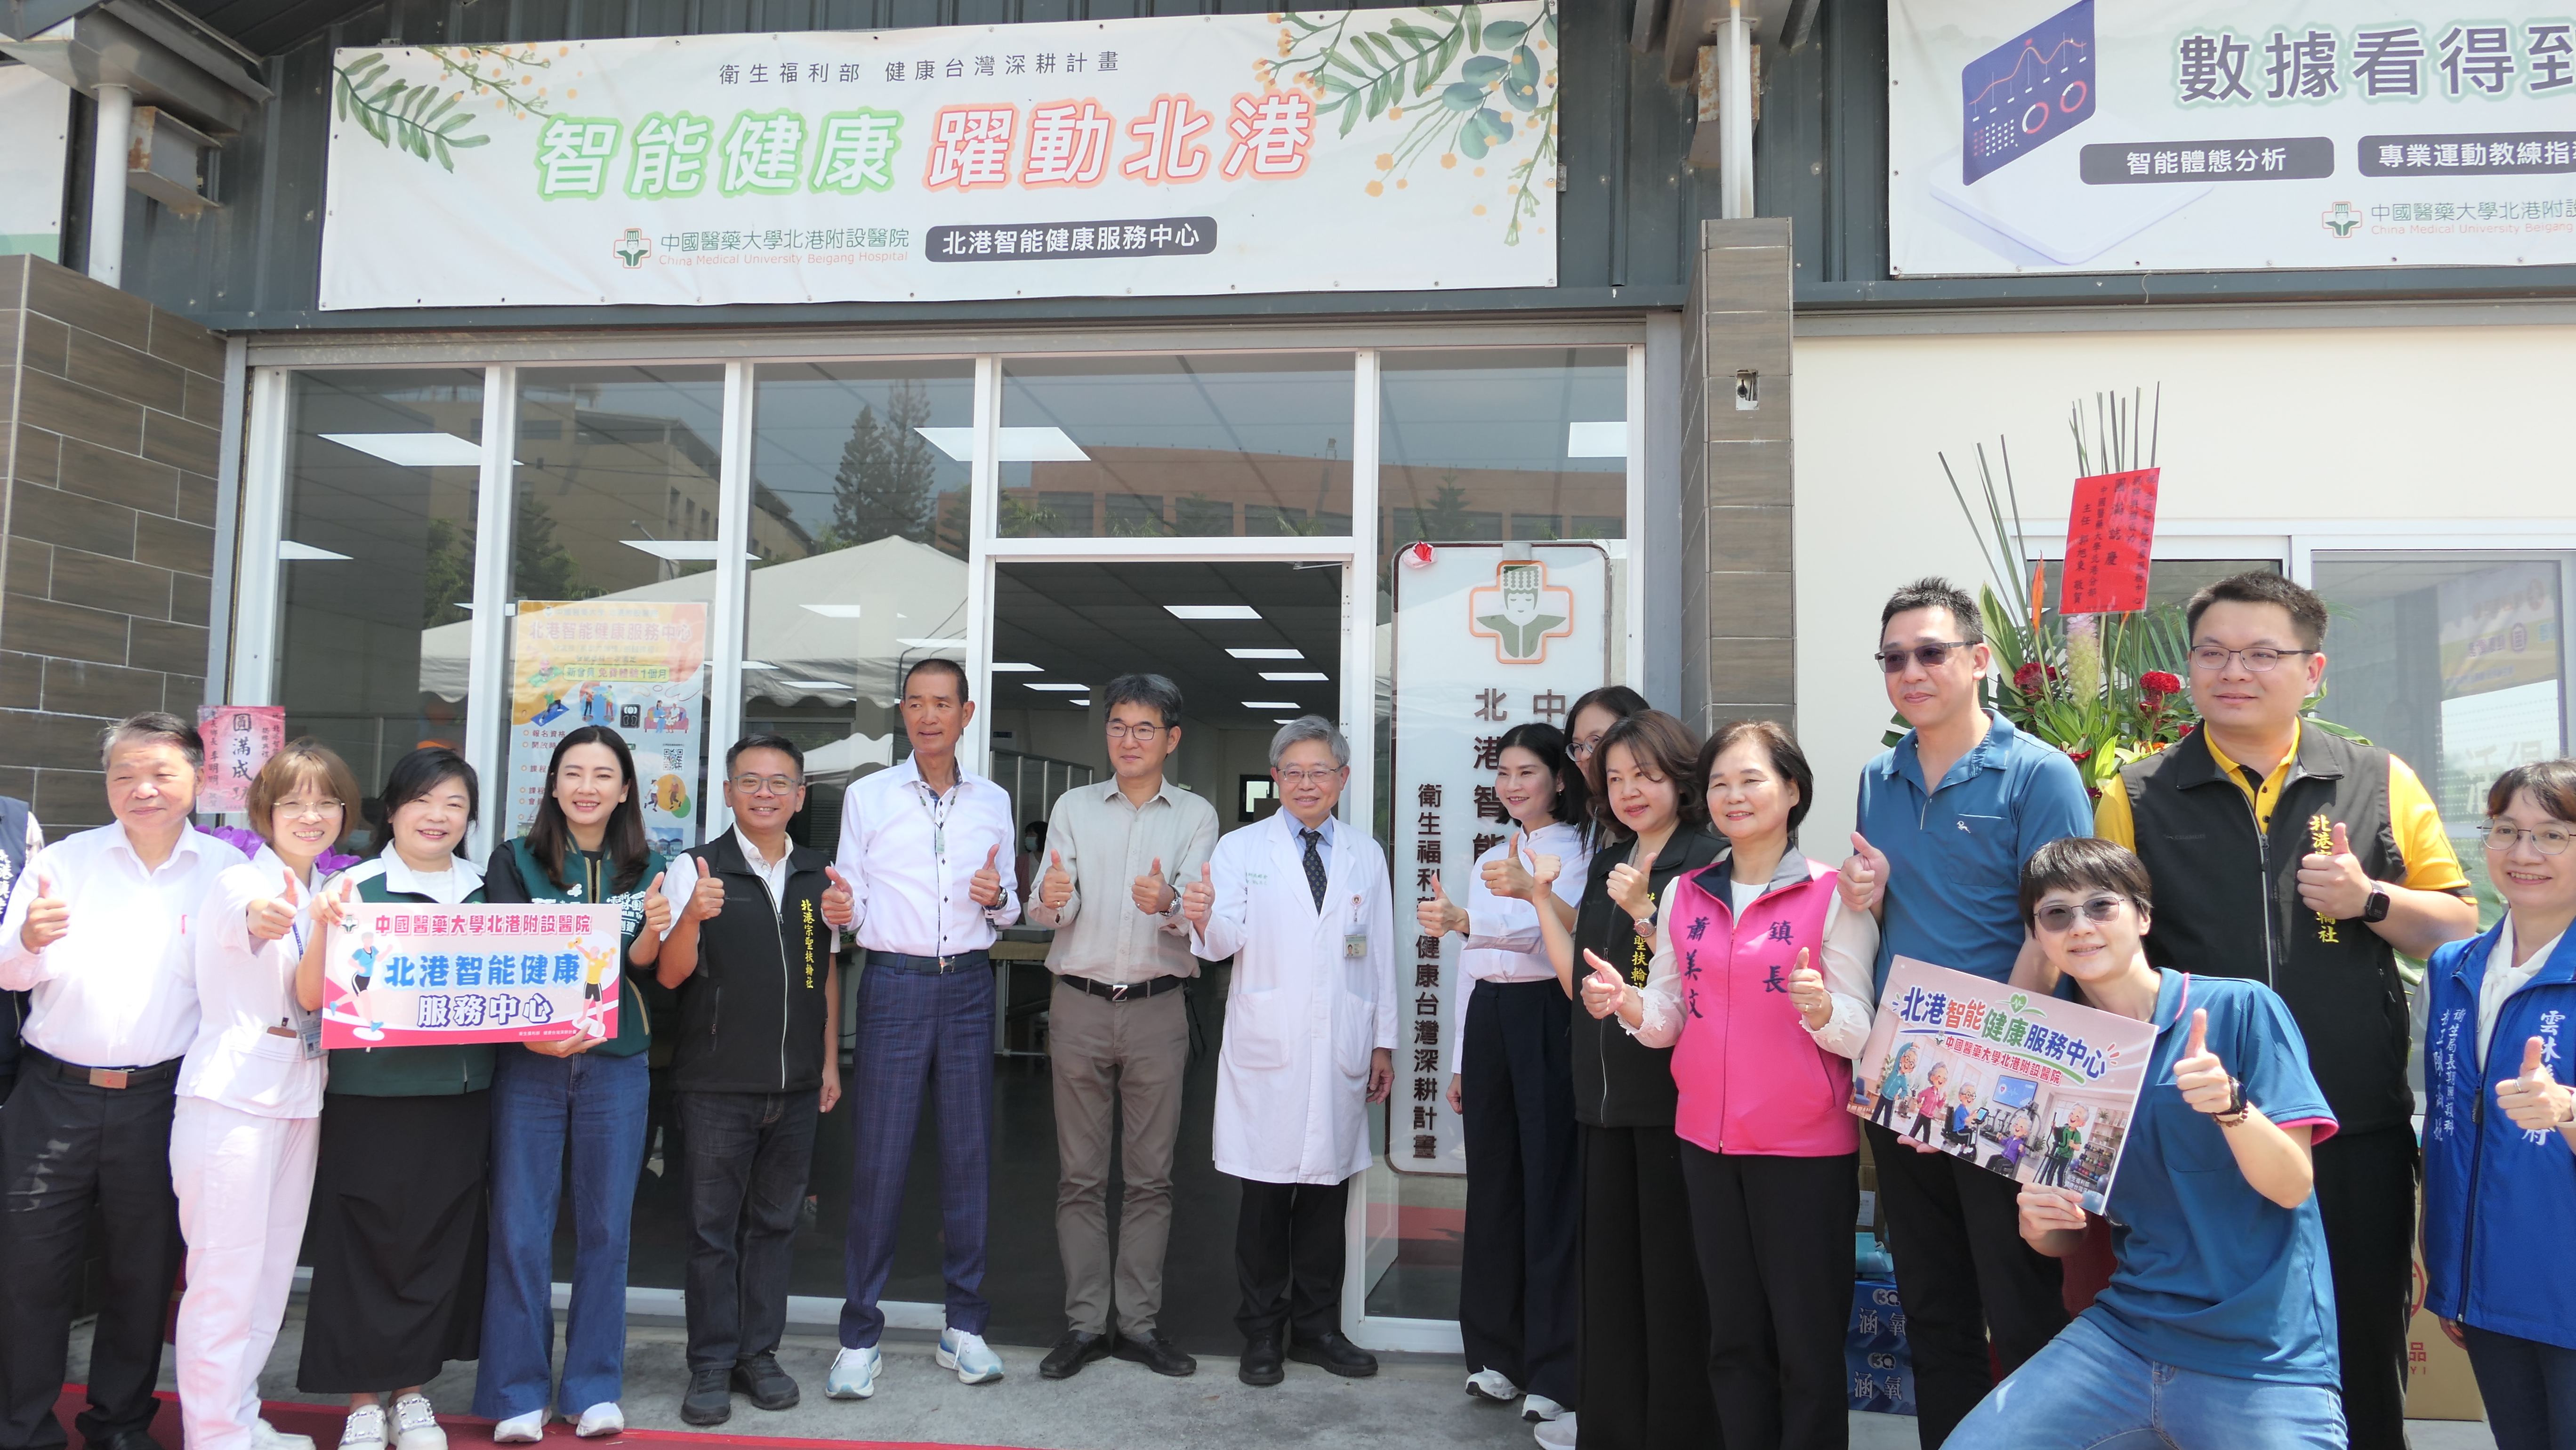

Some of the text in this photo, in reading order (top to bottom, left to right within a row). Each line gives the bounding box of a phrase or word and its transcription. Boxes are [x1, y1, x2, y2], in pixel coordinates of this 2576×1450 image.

[719, 50, 1120, 86] 衛生福利部 健康台灣深耕計畫
[2180, 25, 2576, 102] 數據看得到
[538, 94, 1313, 198] 智能健康 躍動北港
[2126, 146, 2287, 175] 智能體態分析
[2378, 141, 2576, 169] 專業運動教練指
[660, 227, 910, 252] 中國醫藥大學北港附設醫院
[942, 222, 1200, 257] 北港智能健康服務中心
[2371, 222, 2574, 234] China Medical University Beigang
[659, 250, 909, 267] China Medical University Beigang Hospital
[2081, 503, 2091, 526] 主任
[529, 619, 693, 643] 北港智能健康服務中心
[566, 667, 596, 678] 新會員
[532, 730, 565, 738] 報名資格
[375, 914, 593, 935] 中國醫藥大學北港附設醫院
[801, 898, 815, 989] 北港宗聖扶輪社
[1762, 919, 1795, 994] 鎮長
[384, 953, 581, 988] 北港智能健康
[1684, 916, 1711, 1019] 蕭美文
[416, 992, 555, 1028] 服務中心
[1413, 934, 1441, 1160] 健康台灣深耕計畫
[1899, 986, 2107, 1080] 北港智能健康服務中心
[1944, 1035, 2063, 1086] 中國醫藥大學北港附設醫院
[1853, 1370, 1903, 1401] 涵氧
